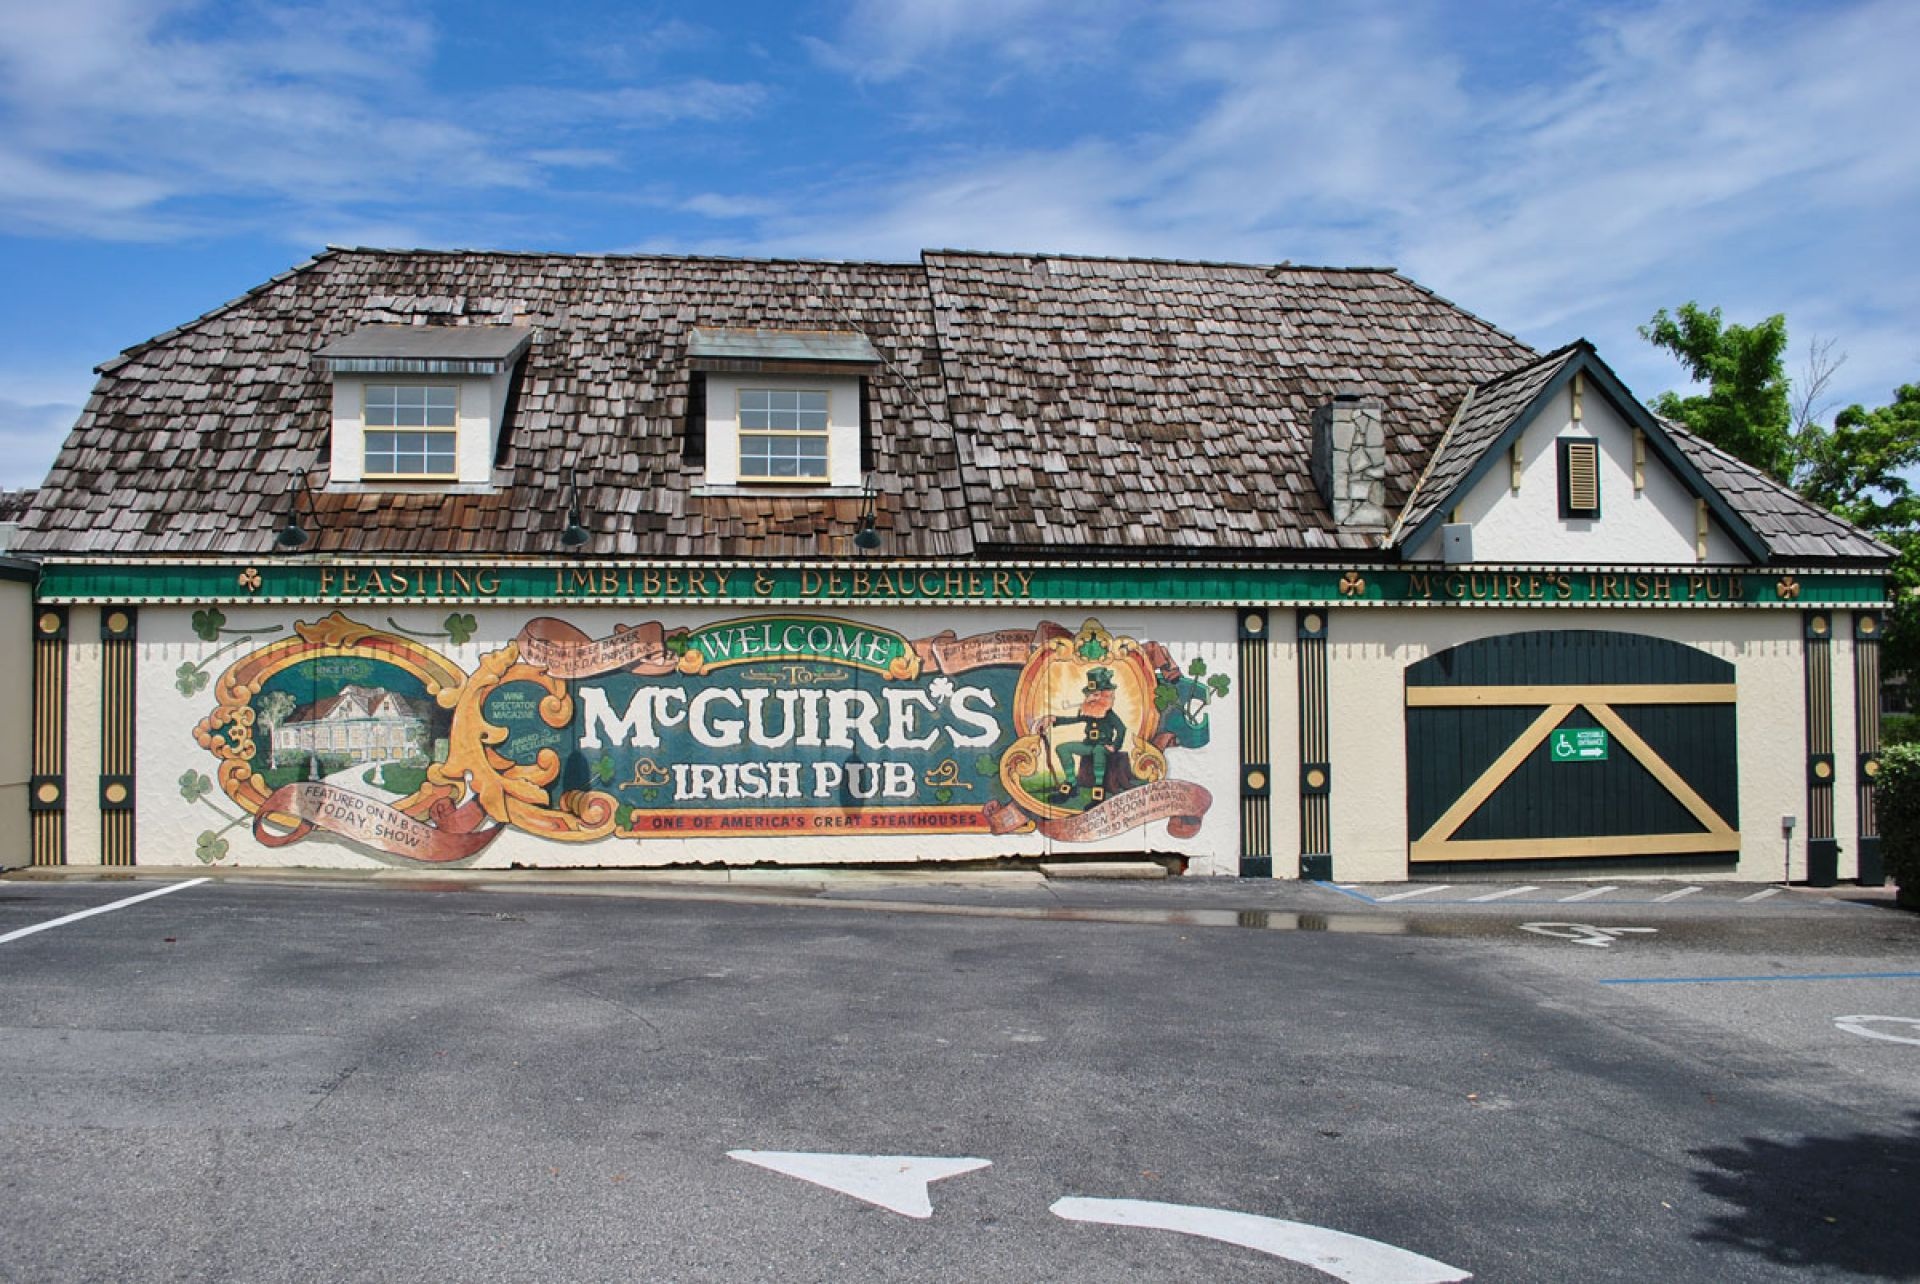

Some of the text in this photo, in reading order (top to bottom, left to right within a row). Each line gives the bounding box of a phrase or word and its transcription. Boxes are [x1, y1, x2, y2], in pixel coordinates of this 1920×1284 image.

[319, 568, 1036, 596] FEASTING IMBIBERY & DEBAUCHERY
[1589, 575, 1671, 599] IRISH
[1688, 575, 1744, 599] PUB
[700, 624, 891, 665] WELCOME
[672, 761, 917, 801] IRISH PUB
[304, 786, 364, 810] FEATURED
[366, 805, 386, 819] ON
[315, 802, 367, 829] TODAY
[652, 814, 977, 829] ONE OF AMERICA'S GREAT STEAKHOUSES
